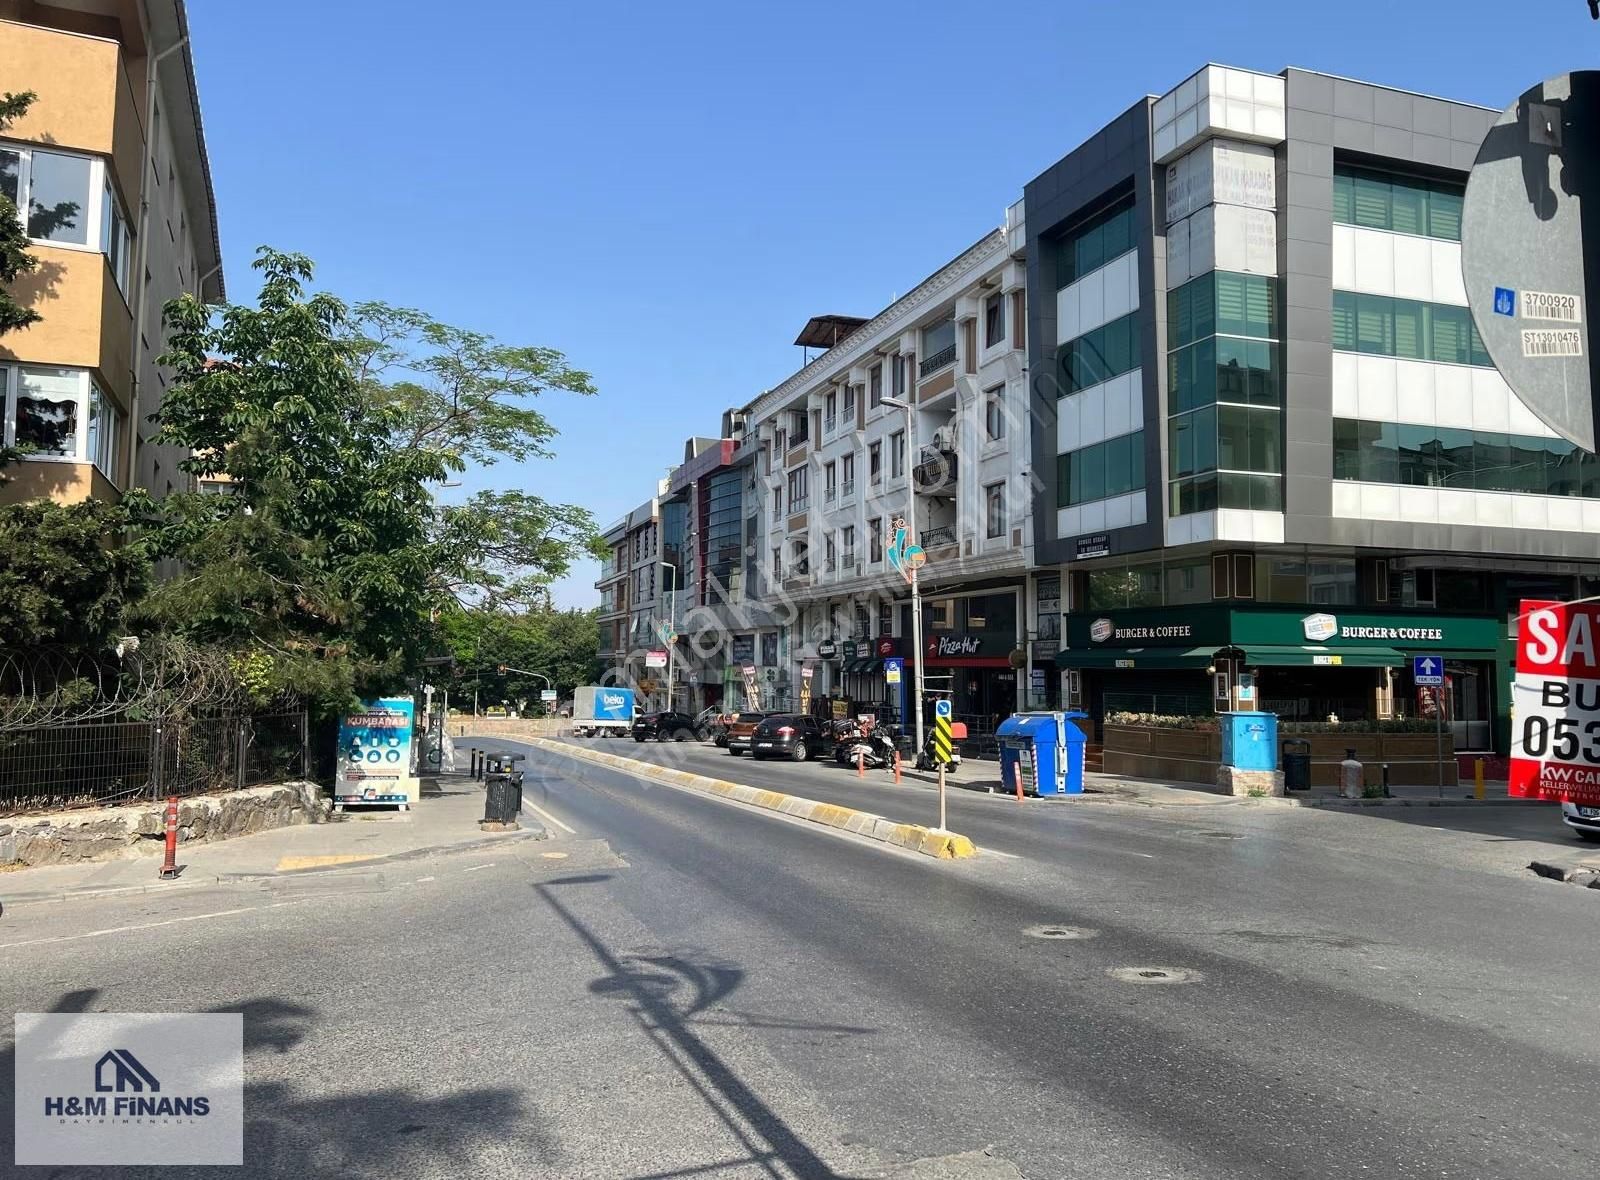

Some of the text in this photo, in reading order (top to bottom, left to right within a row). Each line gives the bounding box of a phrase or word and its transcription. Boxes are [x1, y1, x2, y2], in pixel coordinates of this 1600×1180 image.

[1525, 292, 1575, 309] 3700920
[1524, 331, 1579, 343] ST13010476
[1115, 627, 1148, 639] BURGER
[1149, 629, 1155, 638] &
[1156, 625, 1191, 638] COFFEE
[1342, 626, 1388, 639] BURGER
[1389, 629, 1398, 639] &
[1399, 628, 1443, 640] COFFEE
[1525, 609, 1600, 667] SA
[938, 636, 980, 657] Pizza Hut
[1429, 676, 1442, 684] YÖN
[604, 694, 625, 705] beko
[1541, 680, 1600, 712] BU
[1523, 715, 1600, 765] 053
